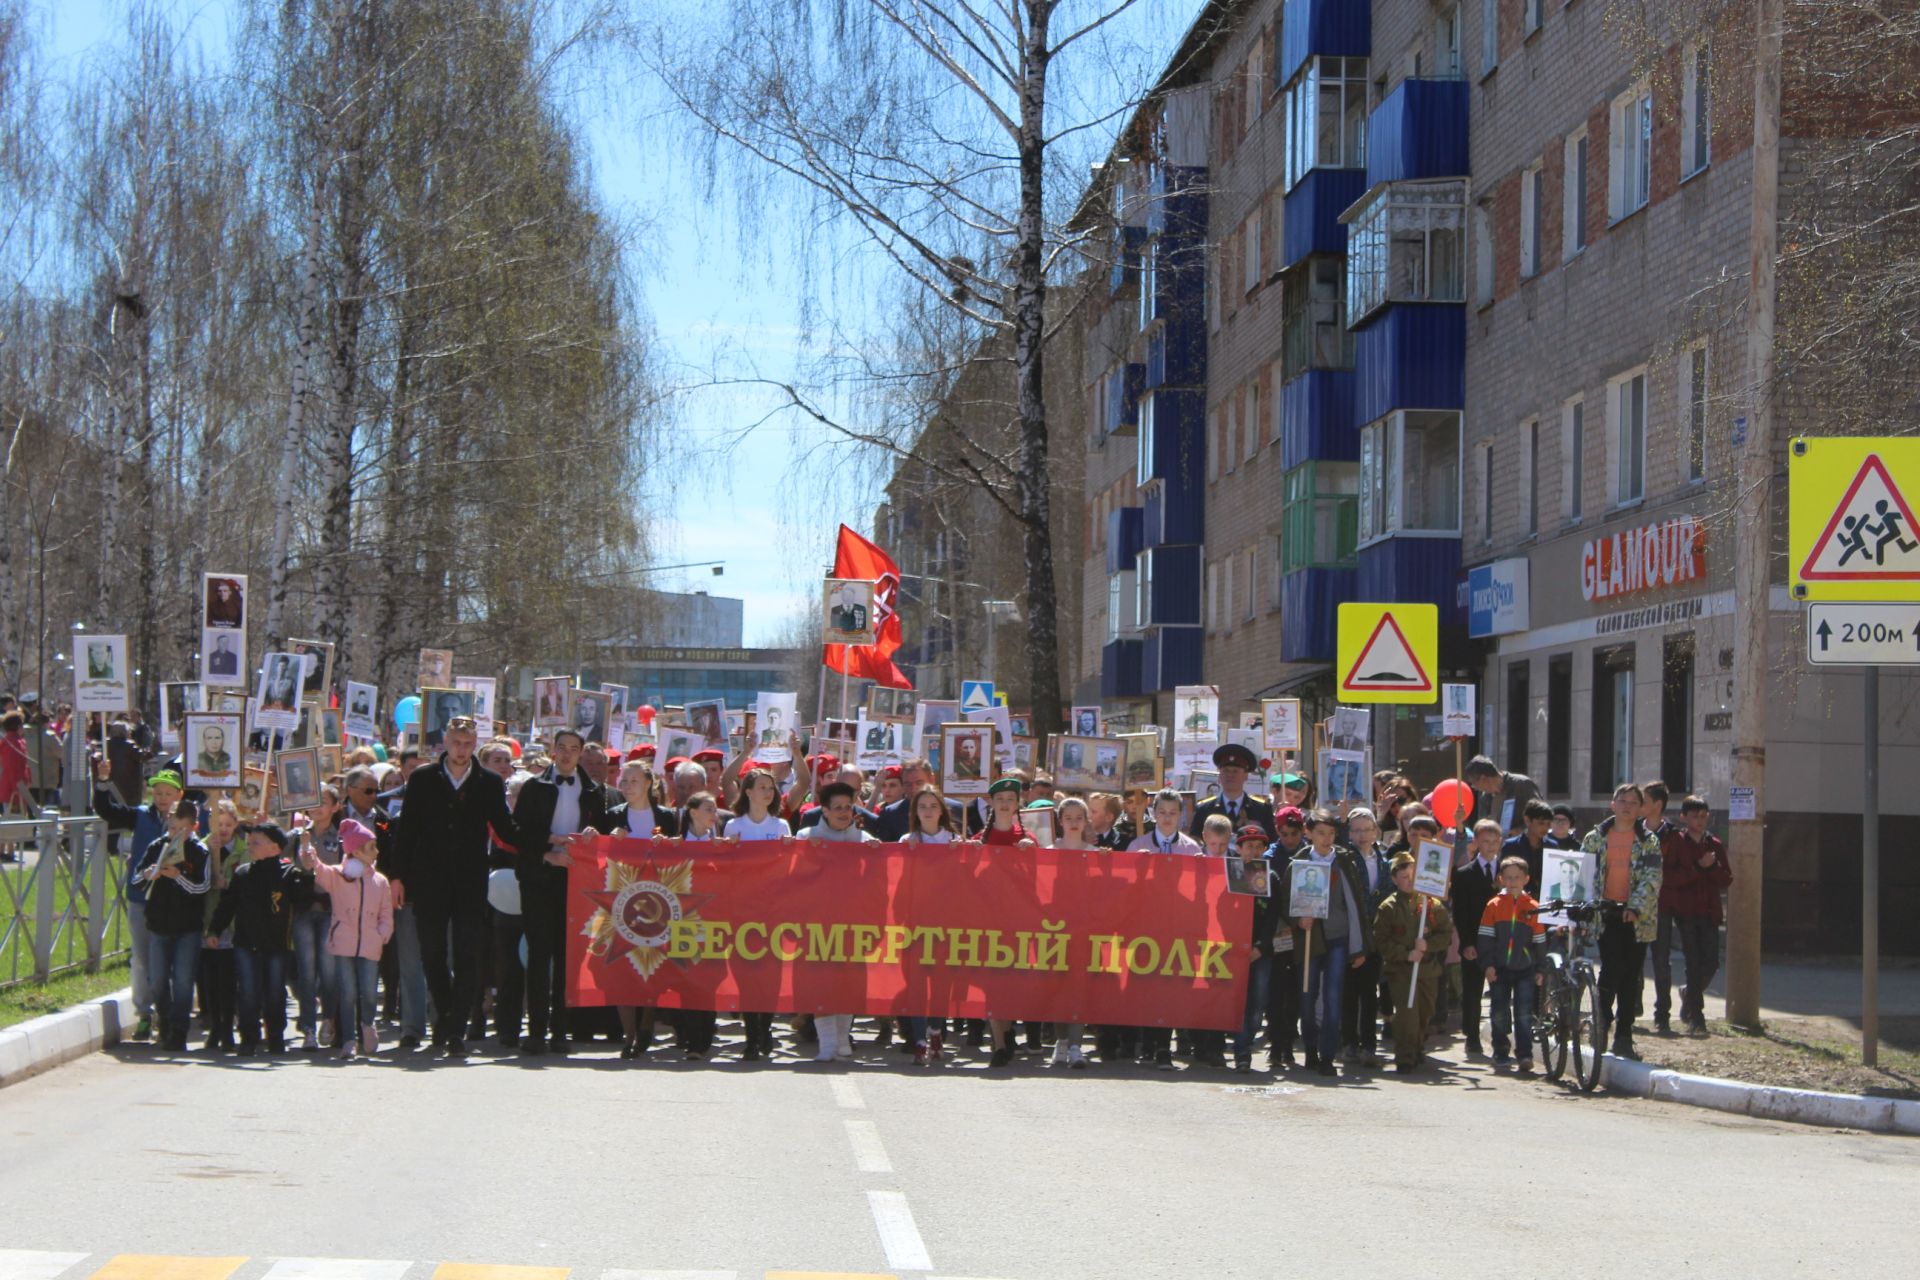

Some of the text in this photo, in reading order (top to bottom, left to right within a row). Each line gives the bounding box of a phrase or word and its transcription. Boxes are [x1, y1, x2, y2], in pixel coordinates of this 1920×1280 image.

[1581, 513, 1696, 601] GLAMOUR
[667, 919, 1234, 980] БЕССМЕРТНЫЙ ПОЛК
